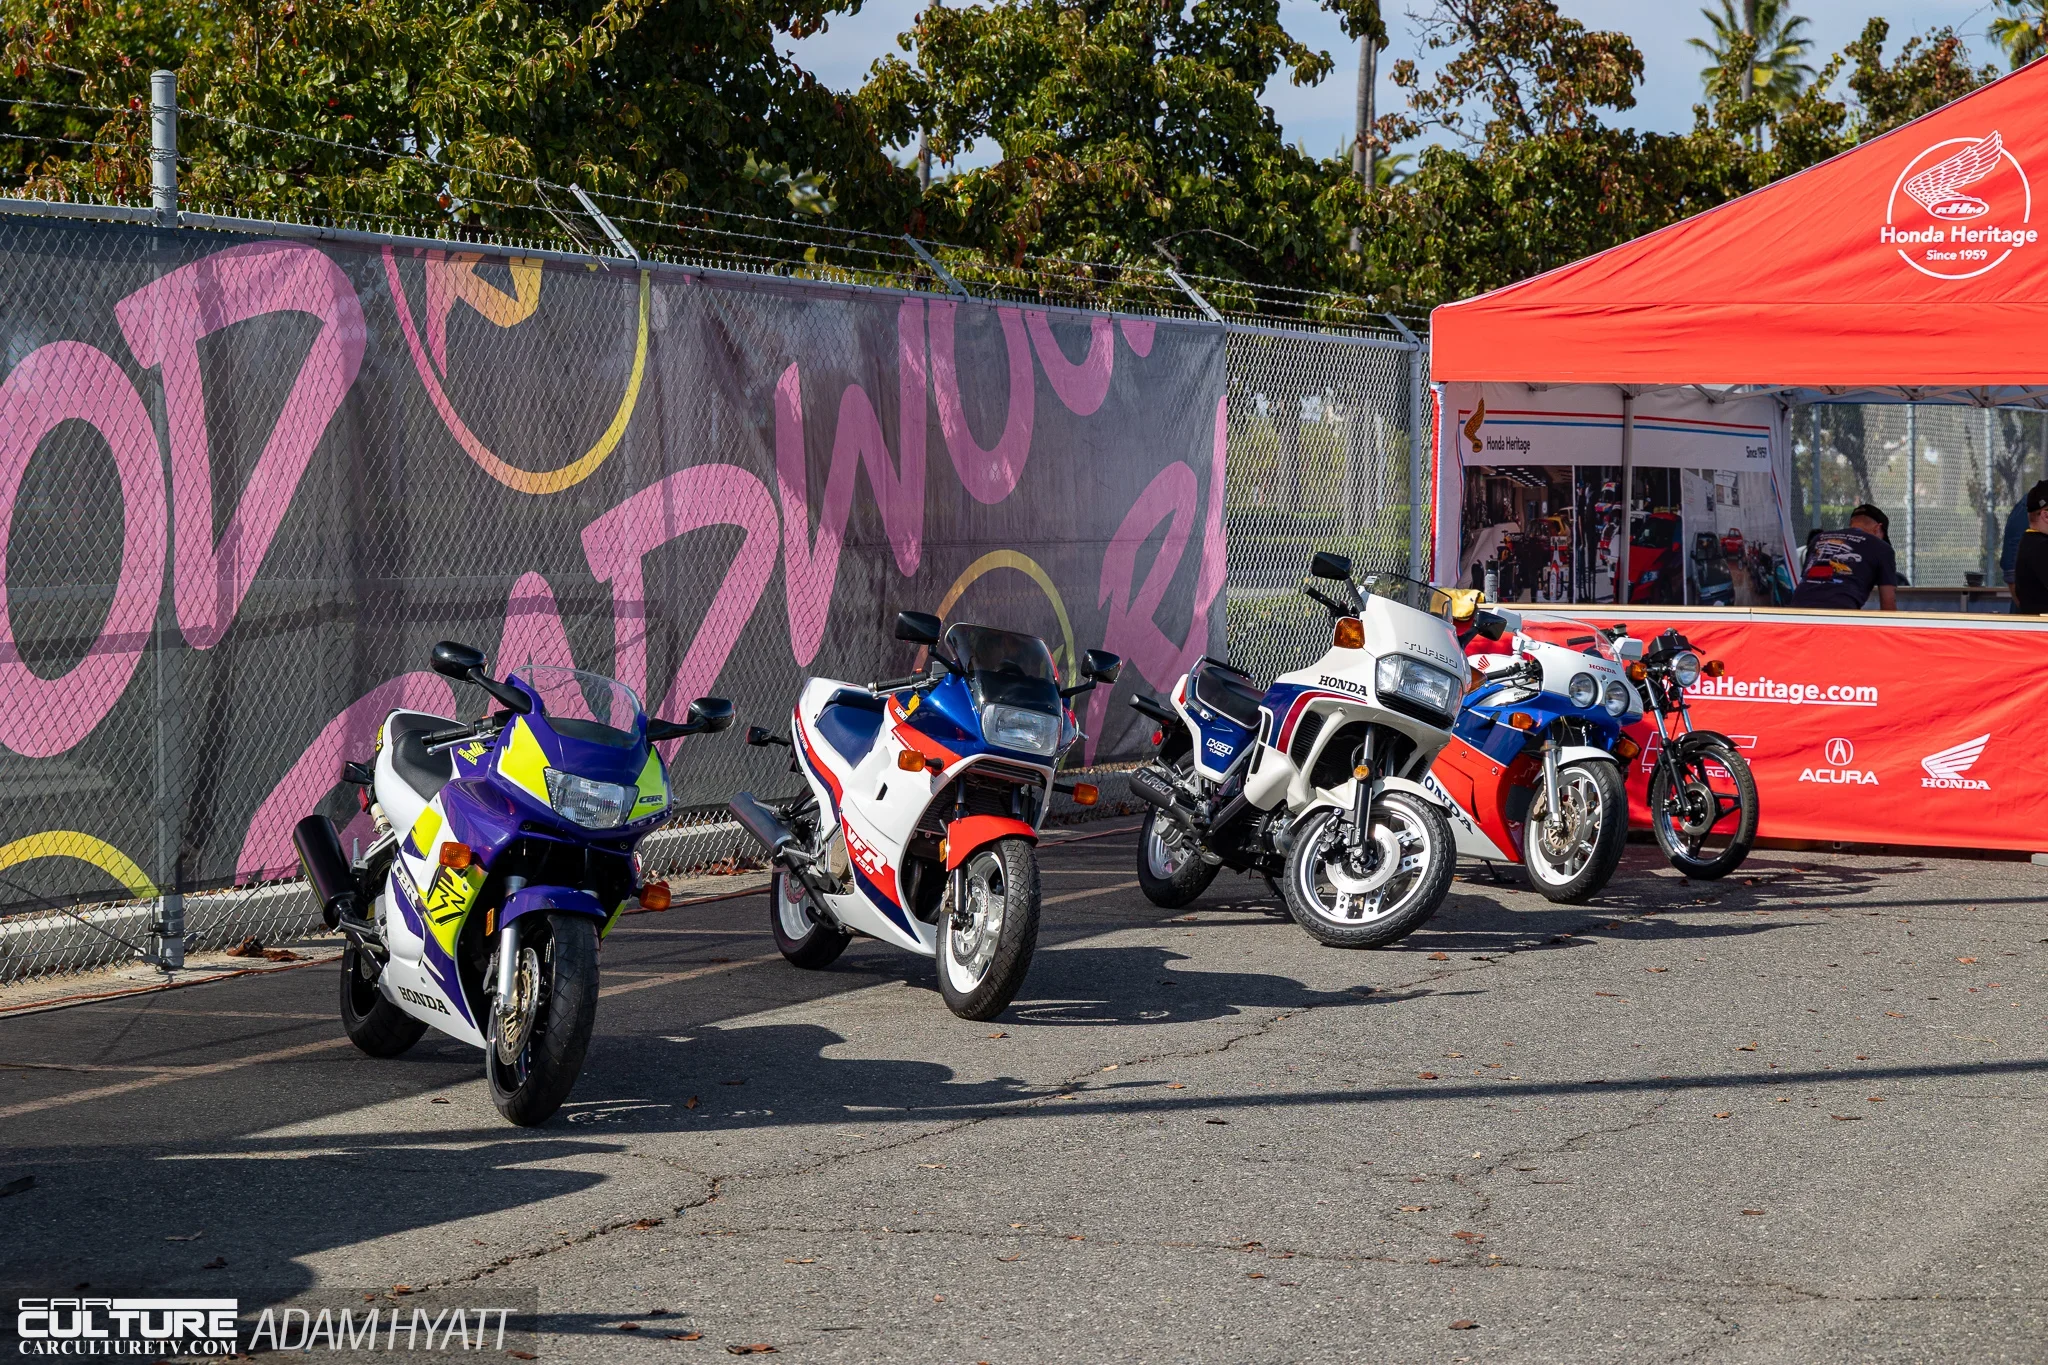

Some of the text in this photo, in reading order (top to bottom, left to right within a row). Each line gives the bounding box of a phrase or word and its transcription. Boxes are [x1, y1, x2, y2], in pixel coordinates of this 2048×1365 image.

[1880, 225, 2038, 248] Honda Heritage
[1926, 249, 1988, 261] Since 1959
[1486, 435, 1531, 455] Honda Heritage
[1745, 446, 1757, 459] Since
[1404, 641, 1458, 668] TURBO
[1588, 663, 1617, 675] HONDA
[1318, 675, 1368, 697] HONDA
[1663, 675, 1878, 705] daHeritage.com
[457, 747, 478, 766] HONDA
[1206, 737, 1234, 756] CX650
[1208, 747, 1226, 758] TURBO
[1136, 769, 1174, 796] TURBO
[1798, 768, 1879, 785] ACURA
[1921, 777, 1991, 790] HONDA
[638, 794, 663, 804] CBR
[1424, 775, 1474, 835] ONDA
[846, 825, 888, 877] VFR
[855, 852, 875, 875] 750
[392, 858, 419, 908] CBR
[397, 985, 451, 1016] HONDA
